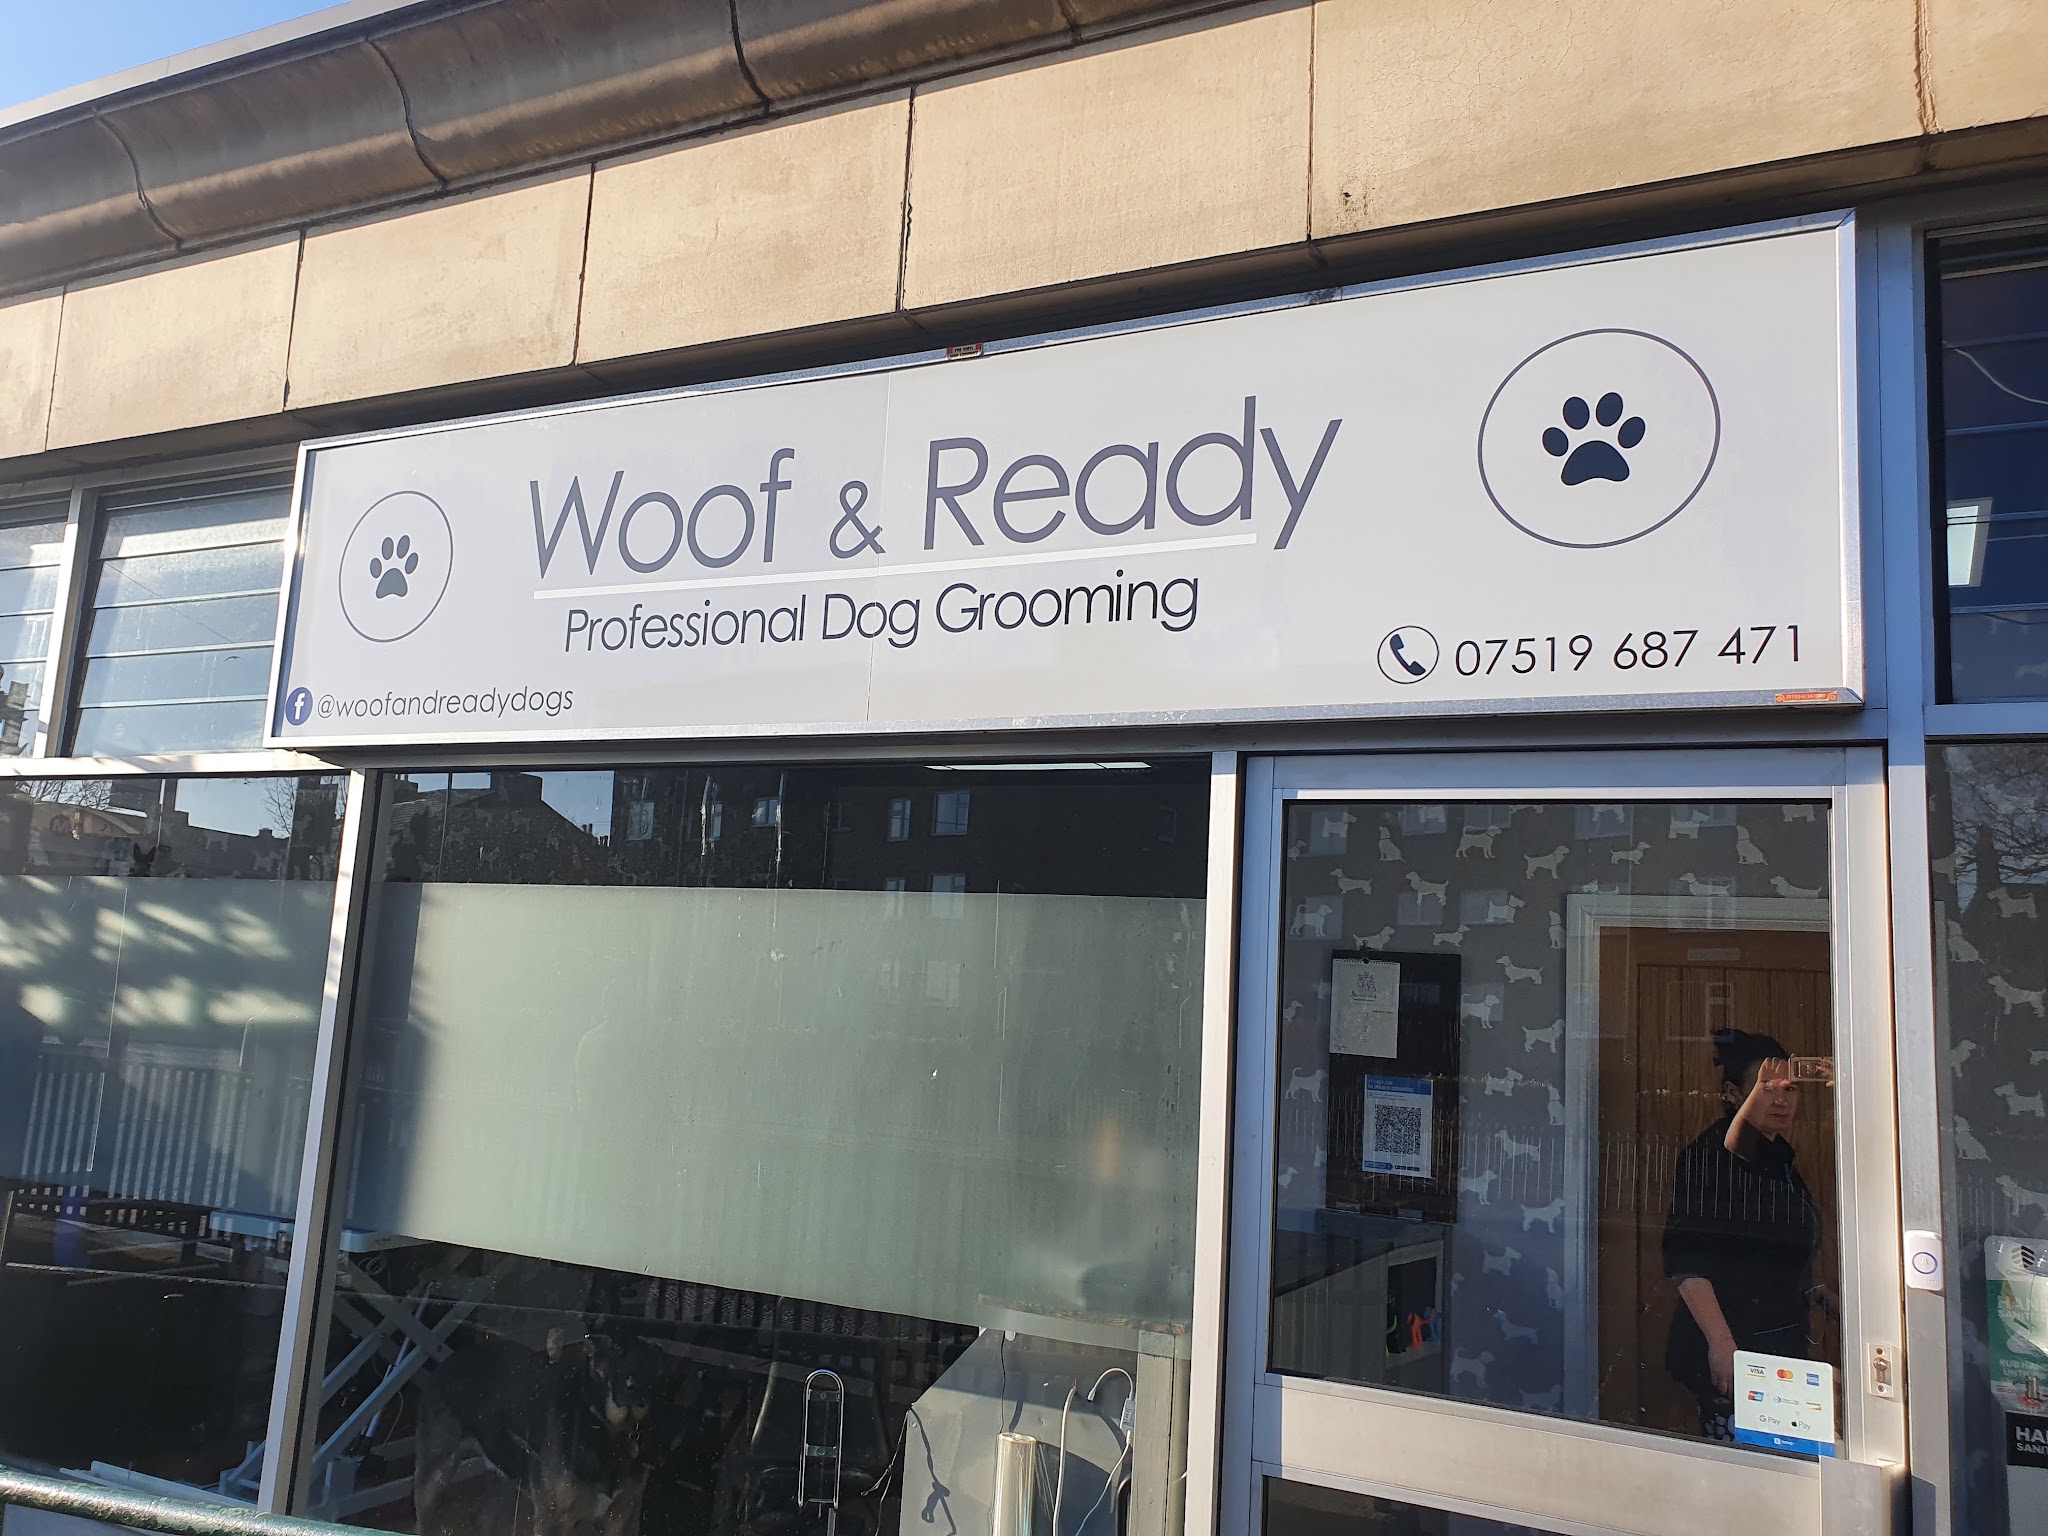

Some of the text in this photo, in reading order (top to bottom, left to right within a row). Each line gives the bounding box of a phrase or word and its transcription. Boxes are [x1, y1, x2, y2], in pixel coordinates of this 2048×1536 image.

[529, 396, 1344, 580] Woof & Ready
[565, 569, 1199, 653] Professional Dog Grooming
[1455, 624, 1801, 677] 07519 687 471
[318, 685, 575, 718] @woofandreadydogs
[1768, 1416, 1780, 1425] Pay
[1798, 1421, 1811, 1431] Pay
